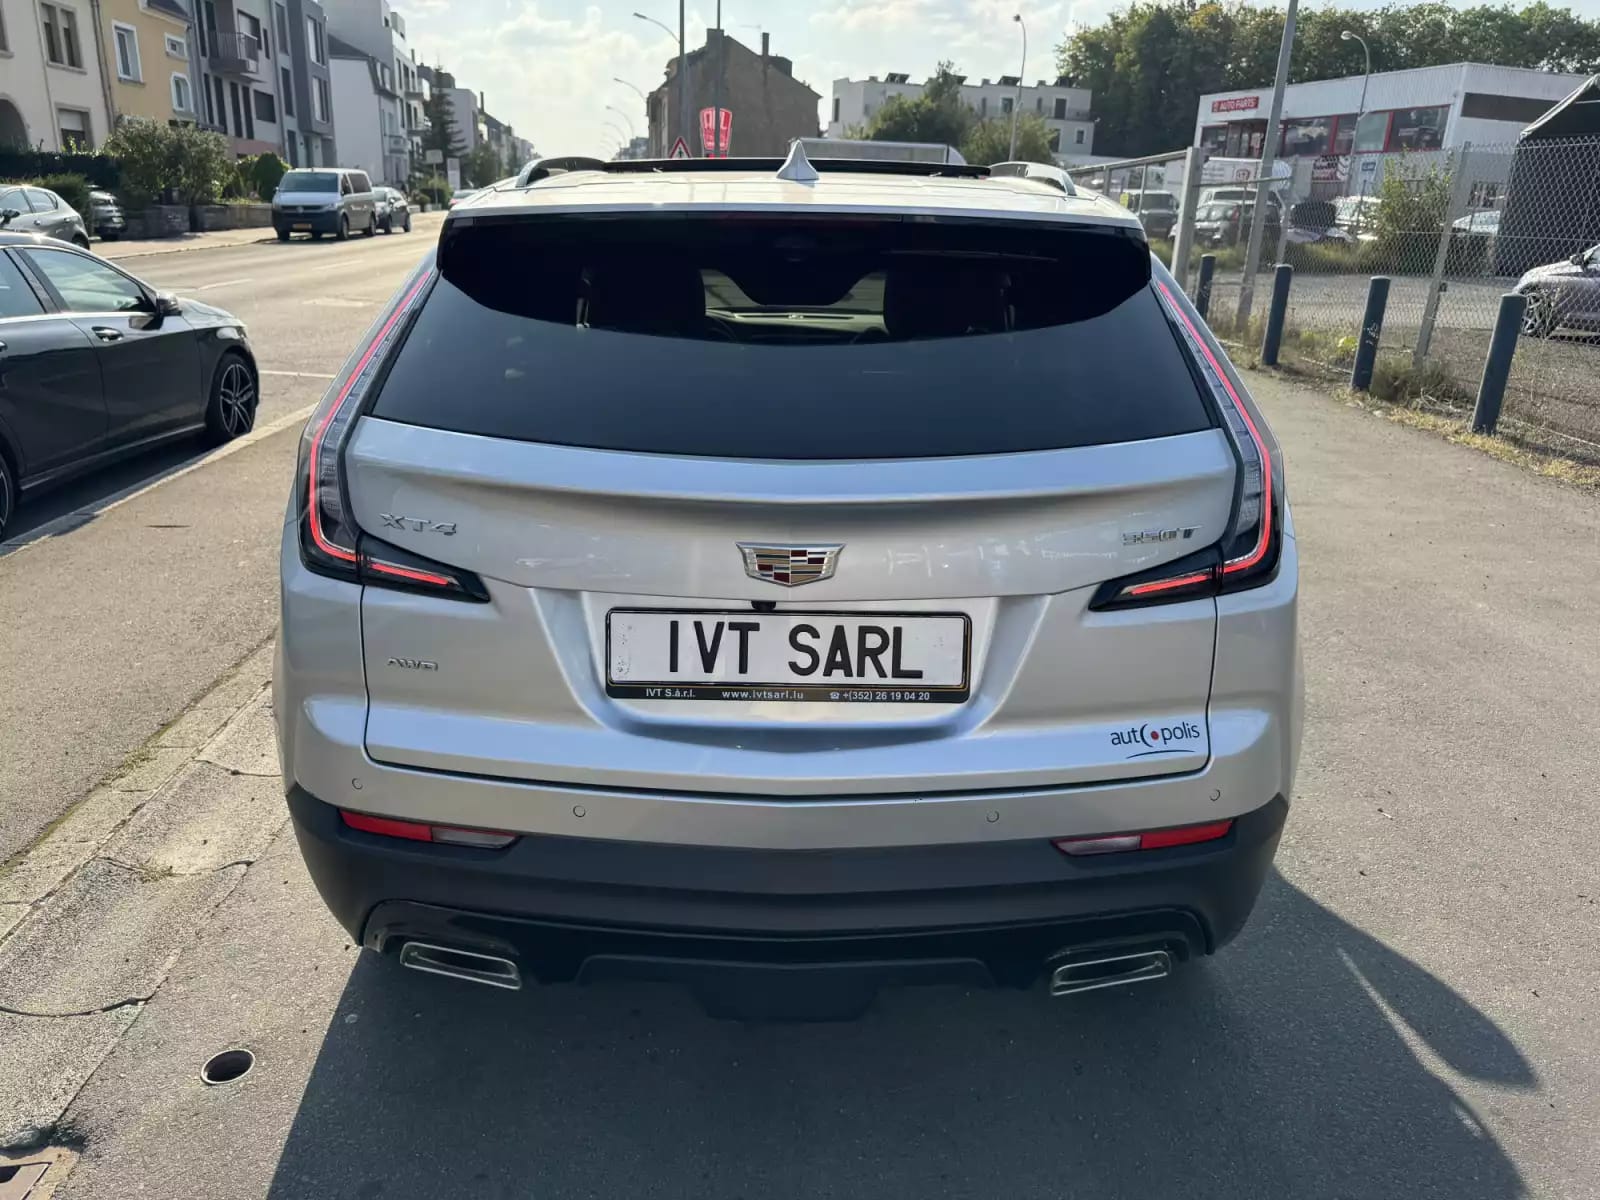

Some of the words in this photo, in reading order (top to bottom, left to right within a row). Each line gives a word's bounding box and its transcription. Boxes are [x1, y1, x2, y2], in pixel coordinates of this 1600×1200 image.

[379, 512, 457, 536] XT4
[788, 623, 923, 679] SARL
[645, 688, 662, 697] IVT
[721, 689, 804, 700] www.ivtsarl.lu
[876, 691, 888, 701] 26
[890, 691, 902, 701] 19
[904, 691, 916, 701] 04
[918, 691, 931, 701] 20
